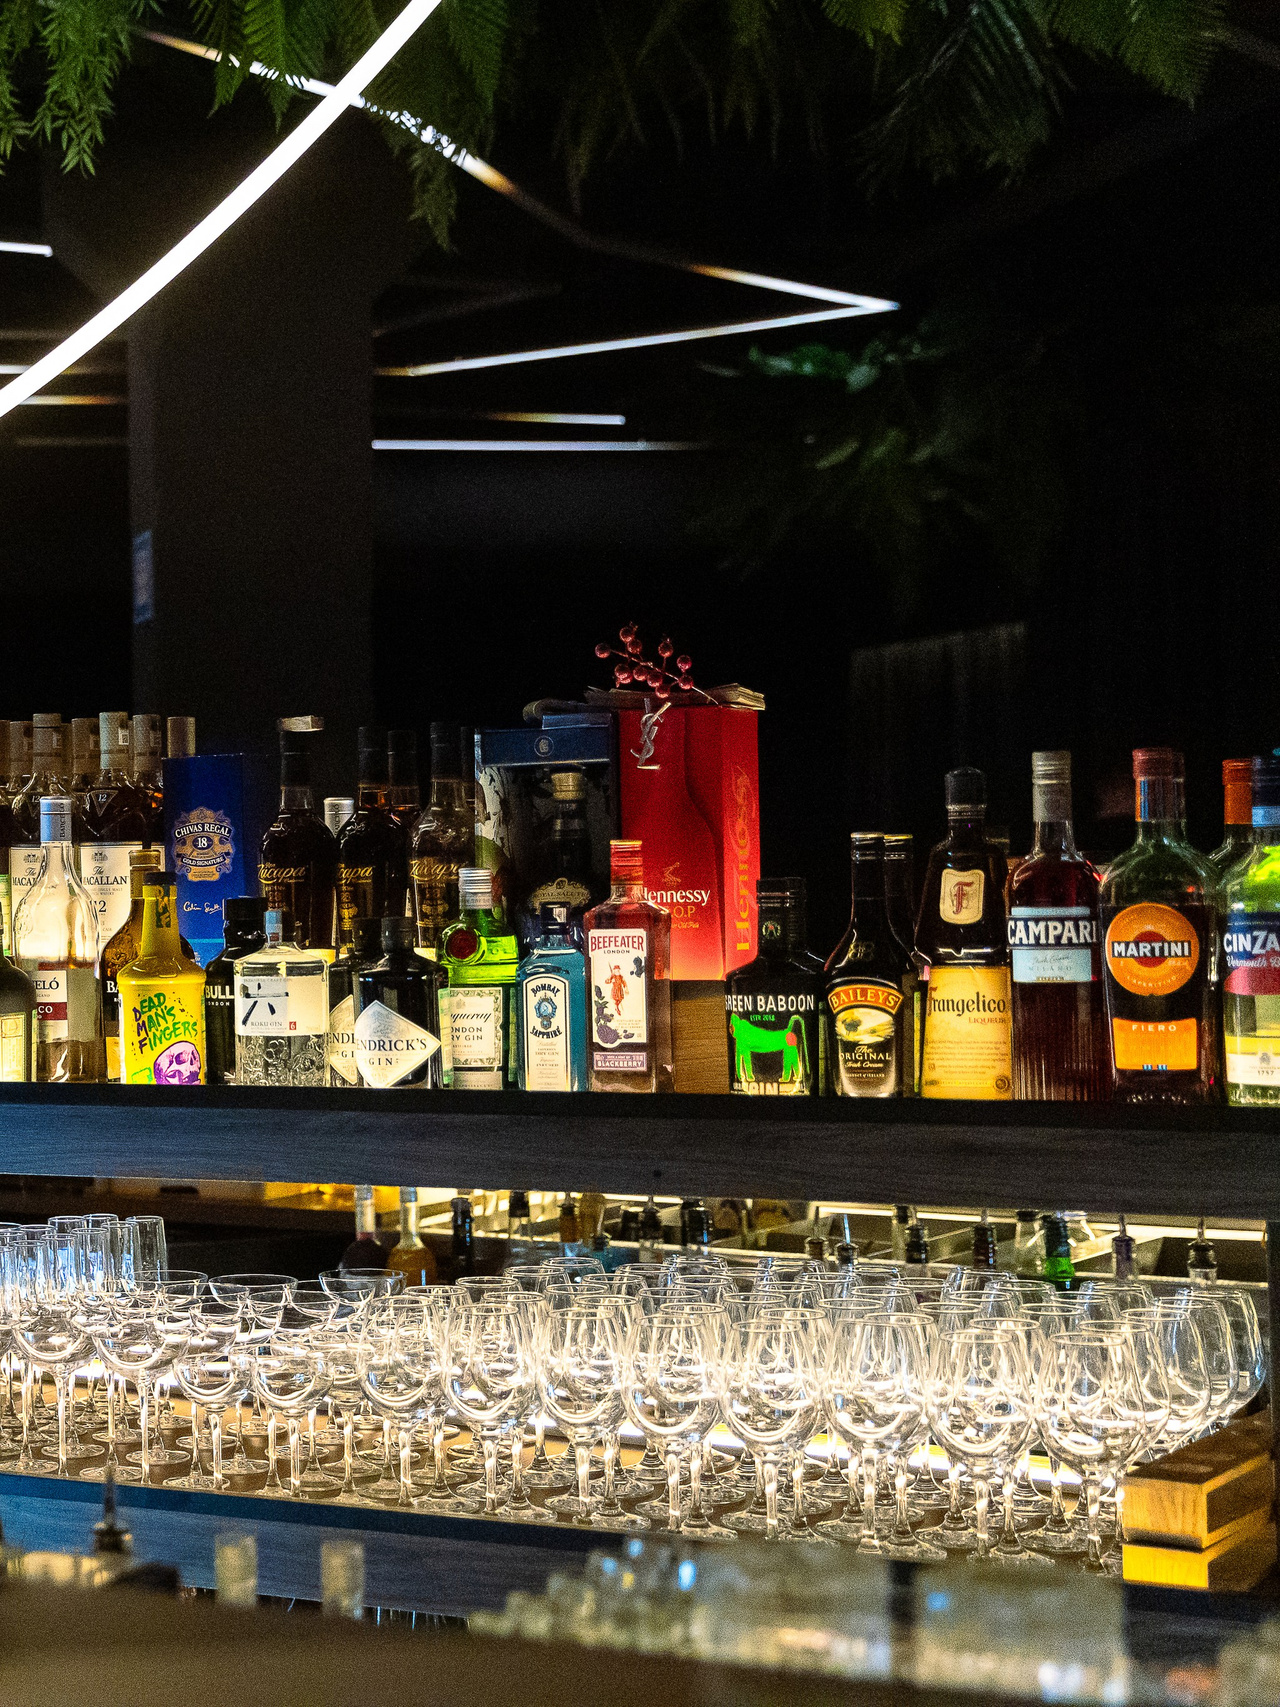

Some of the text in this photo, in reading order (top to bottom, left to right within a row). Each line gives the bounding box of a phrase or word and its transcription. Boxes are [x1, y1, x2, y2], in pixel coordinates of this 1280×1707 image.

[97, 794, 107, 802] 12
[175, 823, 230, 838] CHIVAS REGAL
[197, 837, 208, 848] 18
[182, 857, 225, 866] GOLD SIGNATURE
[92, 865, 105, 876] The
[257, 865, 306, 884] Zacapa
[338, 866, 374, 884] capa
[1007, 920, 1097, 945] CAMPARI
[589, 935, 645, 953] BEEFEATER
[1113, 941, 1190, 957] MARTINI
[1223, 930, 1280, 955] CINZA
[1226, 955, 1267, 967] Vermouth
[205, 985, 235, 999] BULL
[530, 983, 561, 998] BOMBAY
[757, 994, 815, 1012] BABOON
[831, 989, 896, 1008] BAILEYS
[927, 986, 1007, 1017] Frangelico
[133, 992, 167, 1022] DEAD
[136, 1005, 177, 1038] MAN'S
[451, 1012, 492, 1023] queray
[290, 1021, 296, 1030] 6
[530, 1026, 563, 1039] SAPPHIRE
[1131, 1024, 1177, 1032] FIERO
[138, 1021, 198, 1055] FINGERS
[854, 1045, 873, 1054] The
[368, 1057, 394, 1066] GIN
